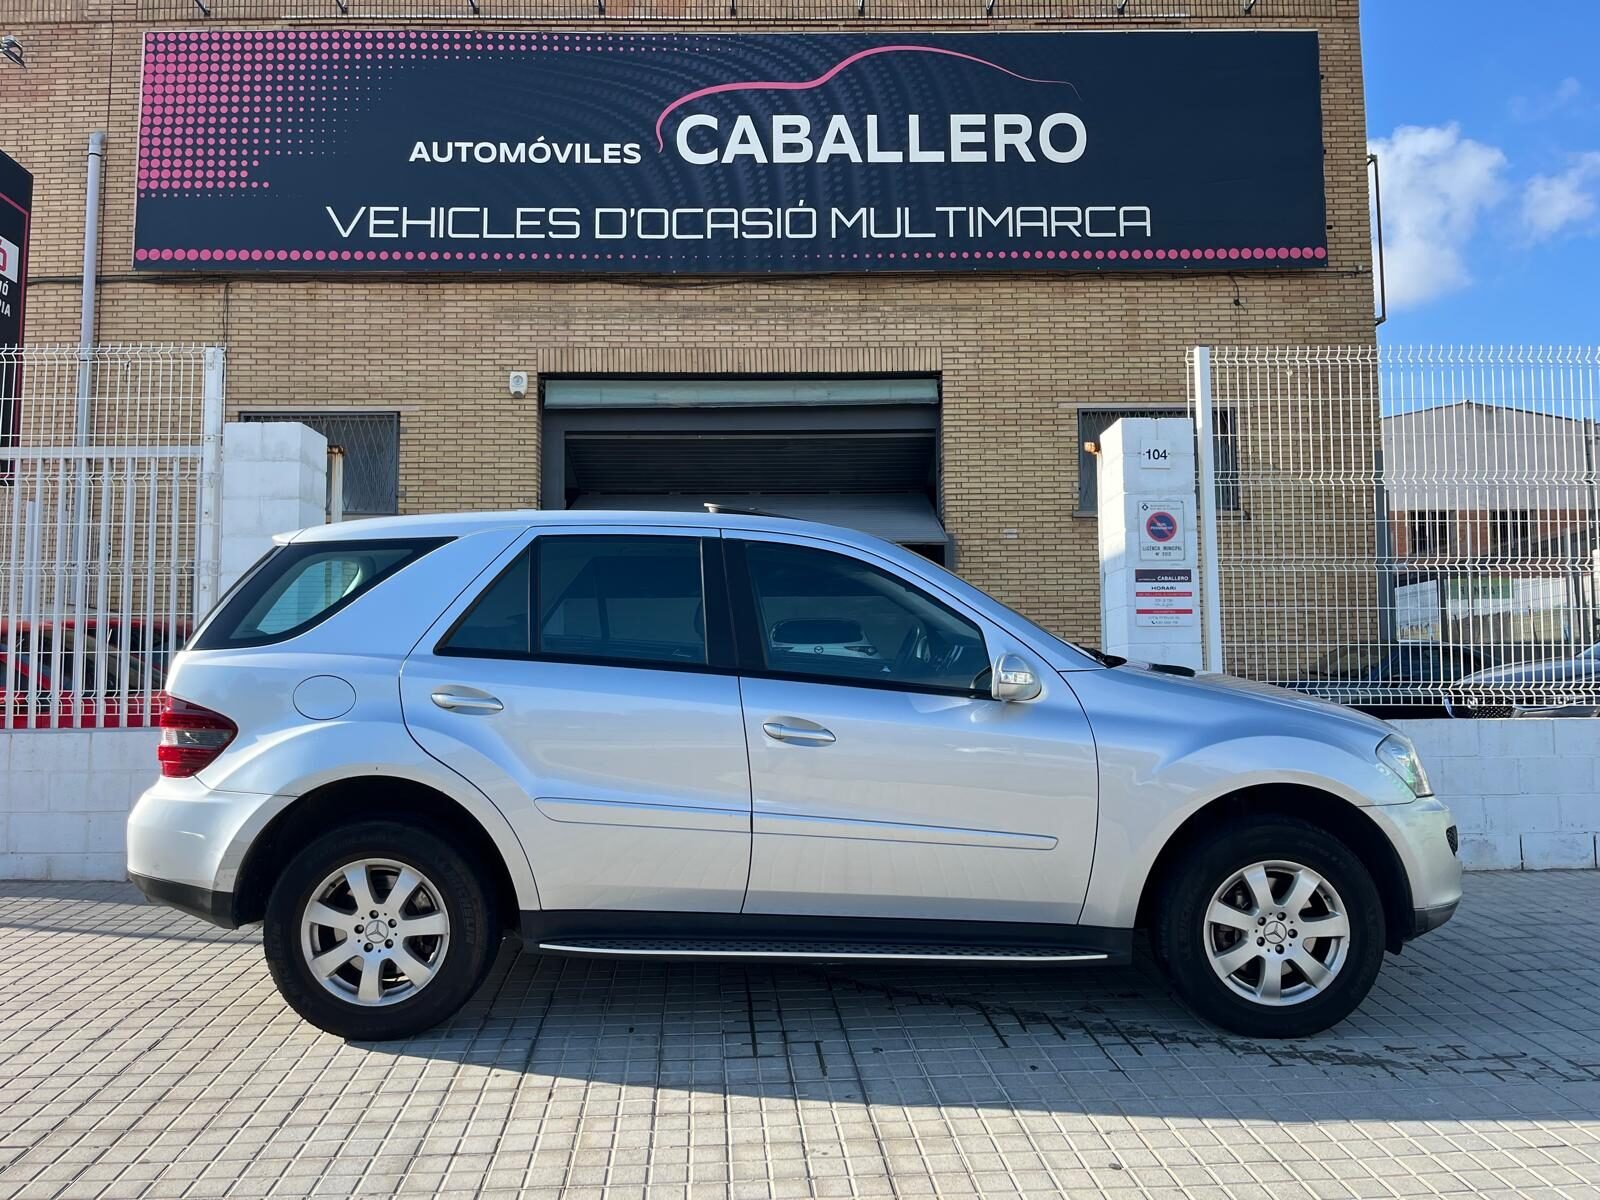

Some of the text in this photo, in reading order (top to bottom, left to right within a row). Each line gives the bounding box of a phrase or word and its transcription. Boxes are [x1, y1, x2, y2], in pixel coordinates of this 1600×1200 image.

[408, 112, 1088, 165] AUTOMÓVILES CABALLERO
[325, 206, 581, 240] VEHICLES
[831, 205, 1152, 240] MULTIMARCA
[1145, 448, 1168, 460] 104
